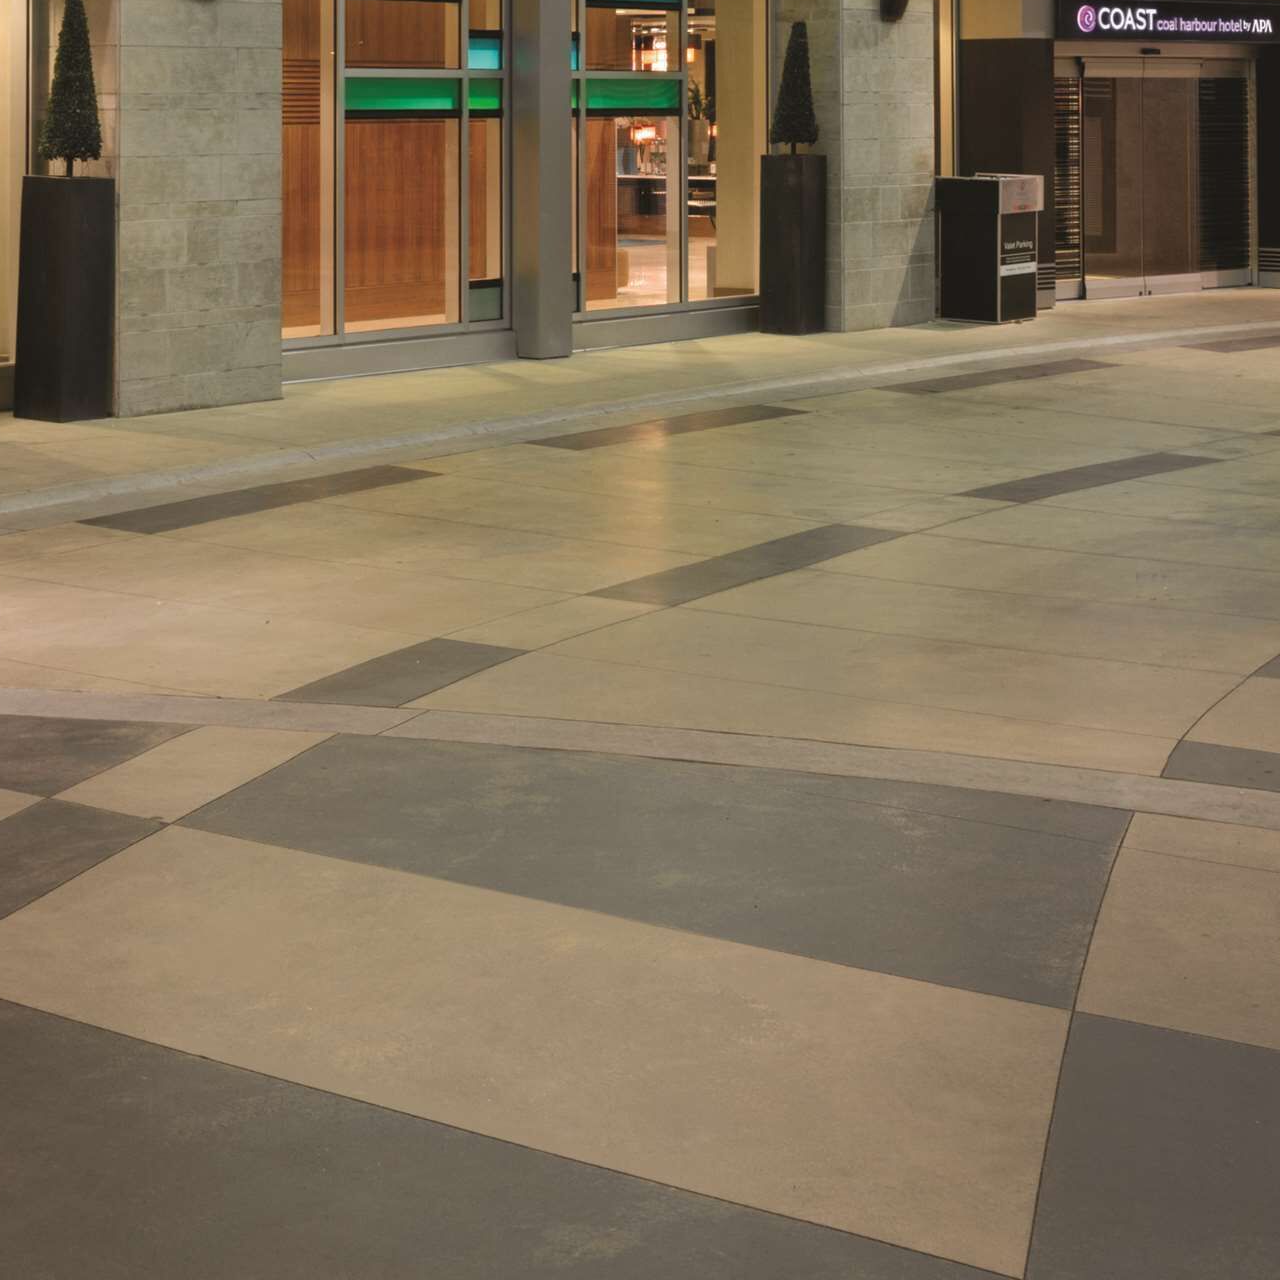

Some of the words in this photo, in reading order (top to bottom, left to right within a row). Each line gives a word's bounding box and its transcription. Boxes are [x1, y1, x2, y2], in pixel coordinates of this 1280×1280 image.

[1098, 6, 1157, 31] COAST
[1157, 18, 1178, 31] coal
[1180, 17, 1217, 32] harbour
[1219, 18, 1242, 33] hotel
[1243, 20, 1252, 33] by
[1252, 19, 1272, 33] APA
[1016, 239, 1033, 250] Parking
